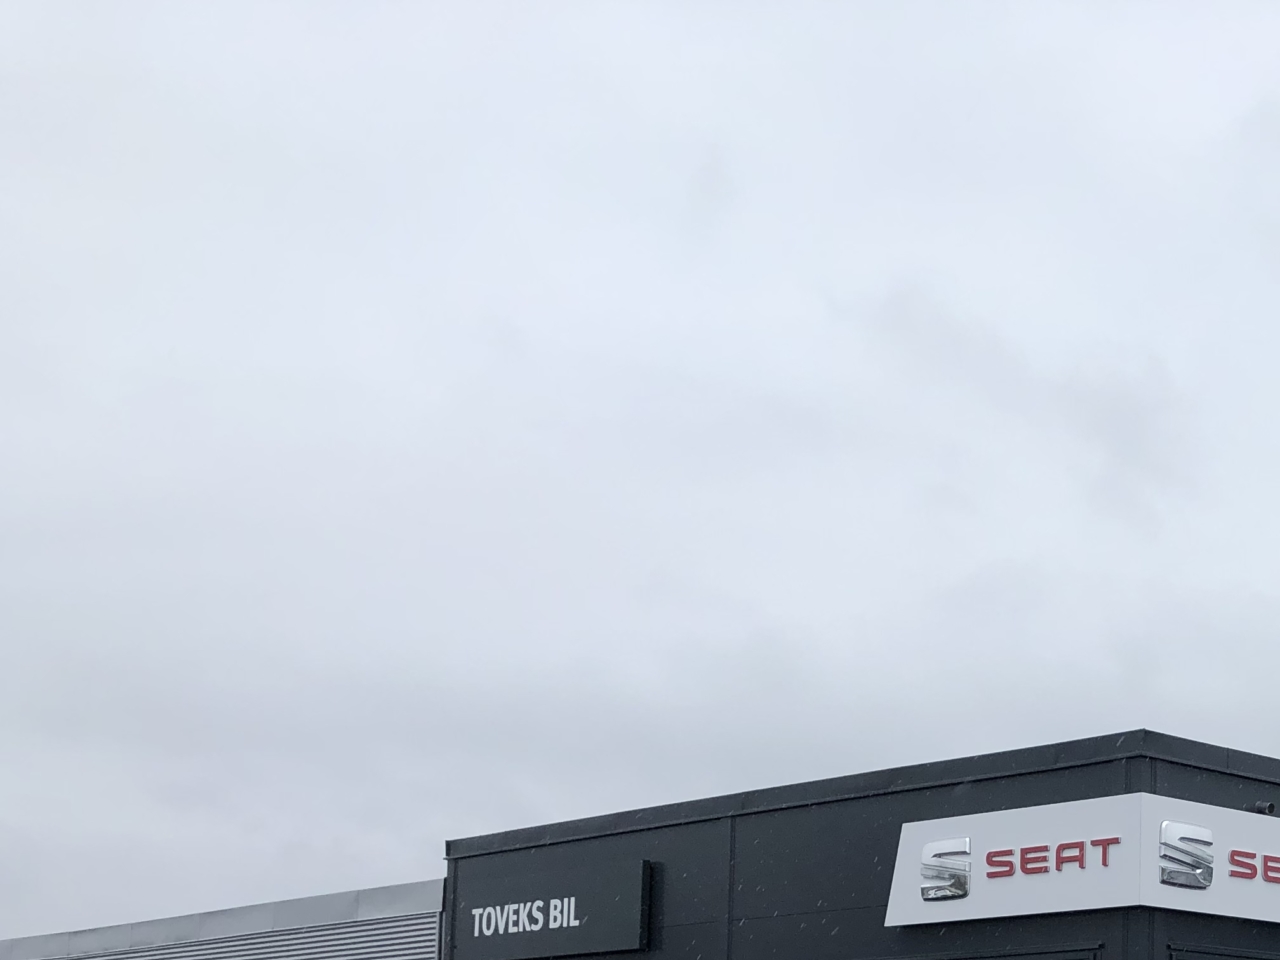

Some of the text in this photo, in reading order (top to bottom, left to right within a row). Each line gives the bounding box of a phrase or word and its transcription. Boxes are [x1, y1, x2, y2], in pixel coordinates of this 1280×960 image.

[985, 837, 1122, 879] SEAT
[471, 897, 580, 937] TOVEKS BIL
